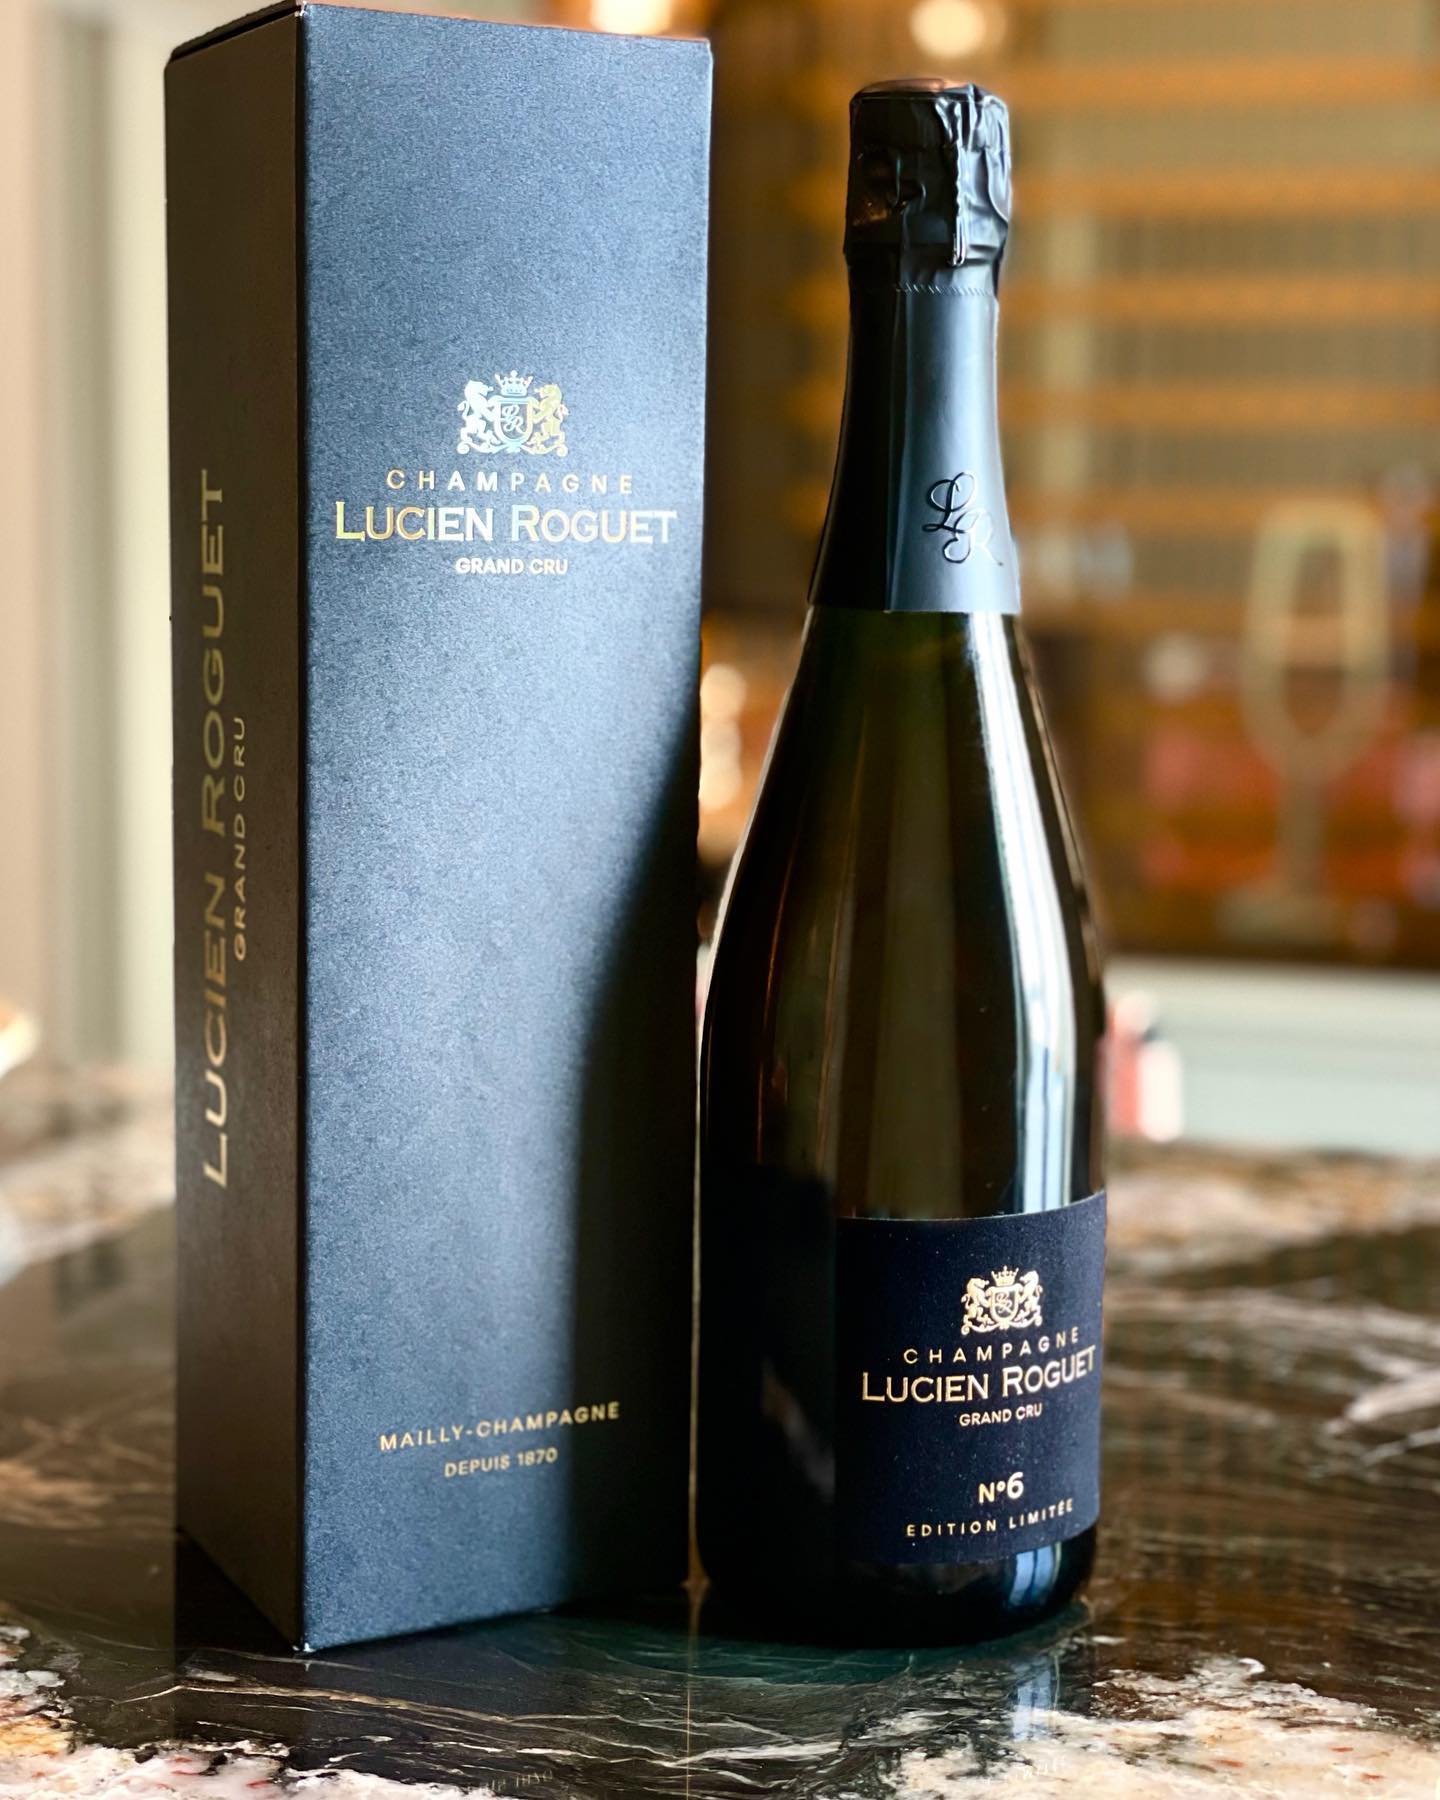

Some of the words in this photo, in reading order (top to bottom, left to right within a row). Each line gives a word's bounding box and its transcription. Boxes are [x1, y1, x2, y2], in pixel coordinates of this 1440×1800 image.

[386, 469, 632, 495] CHAMPAGNE
[335, 501, 494, 542] LUCIEN
[511, 505, 677, 543] ROGUET
[456, 557, 524, 575] GRAND
[529, 558, 568, 575] CRU
[201, 469, 225, 836] ROGUET
[233, 717, 246, 802] CRU
[234, 813, 247, 962] GRAND
[203, 872, 227, 1189] LUCIEN
[903, 1327, 1079, 1364] CHAMPAGNE
[862, 1372, 989, 1402] LUCIEN
[1002, 1345, 1096, 1398] ROGUET
[380, 1401, 620, 1451] MAILLY-CHAMPAGNE
[959, 1407, 1012, 1427] GRAND
[1016, 1403, 1042, 1421] CRU
[444, 1457, 510, 1477] DEPUIS
[517, 1448, 558, 1465] 1870
[906, 1519, 997, 1538] EDITION
[1009, 1498, 1073, 1529] LIMITÉE
